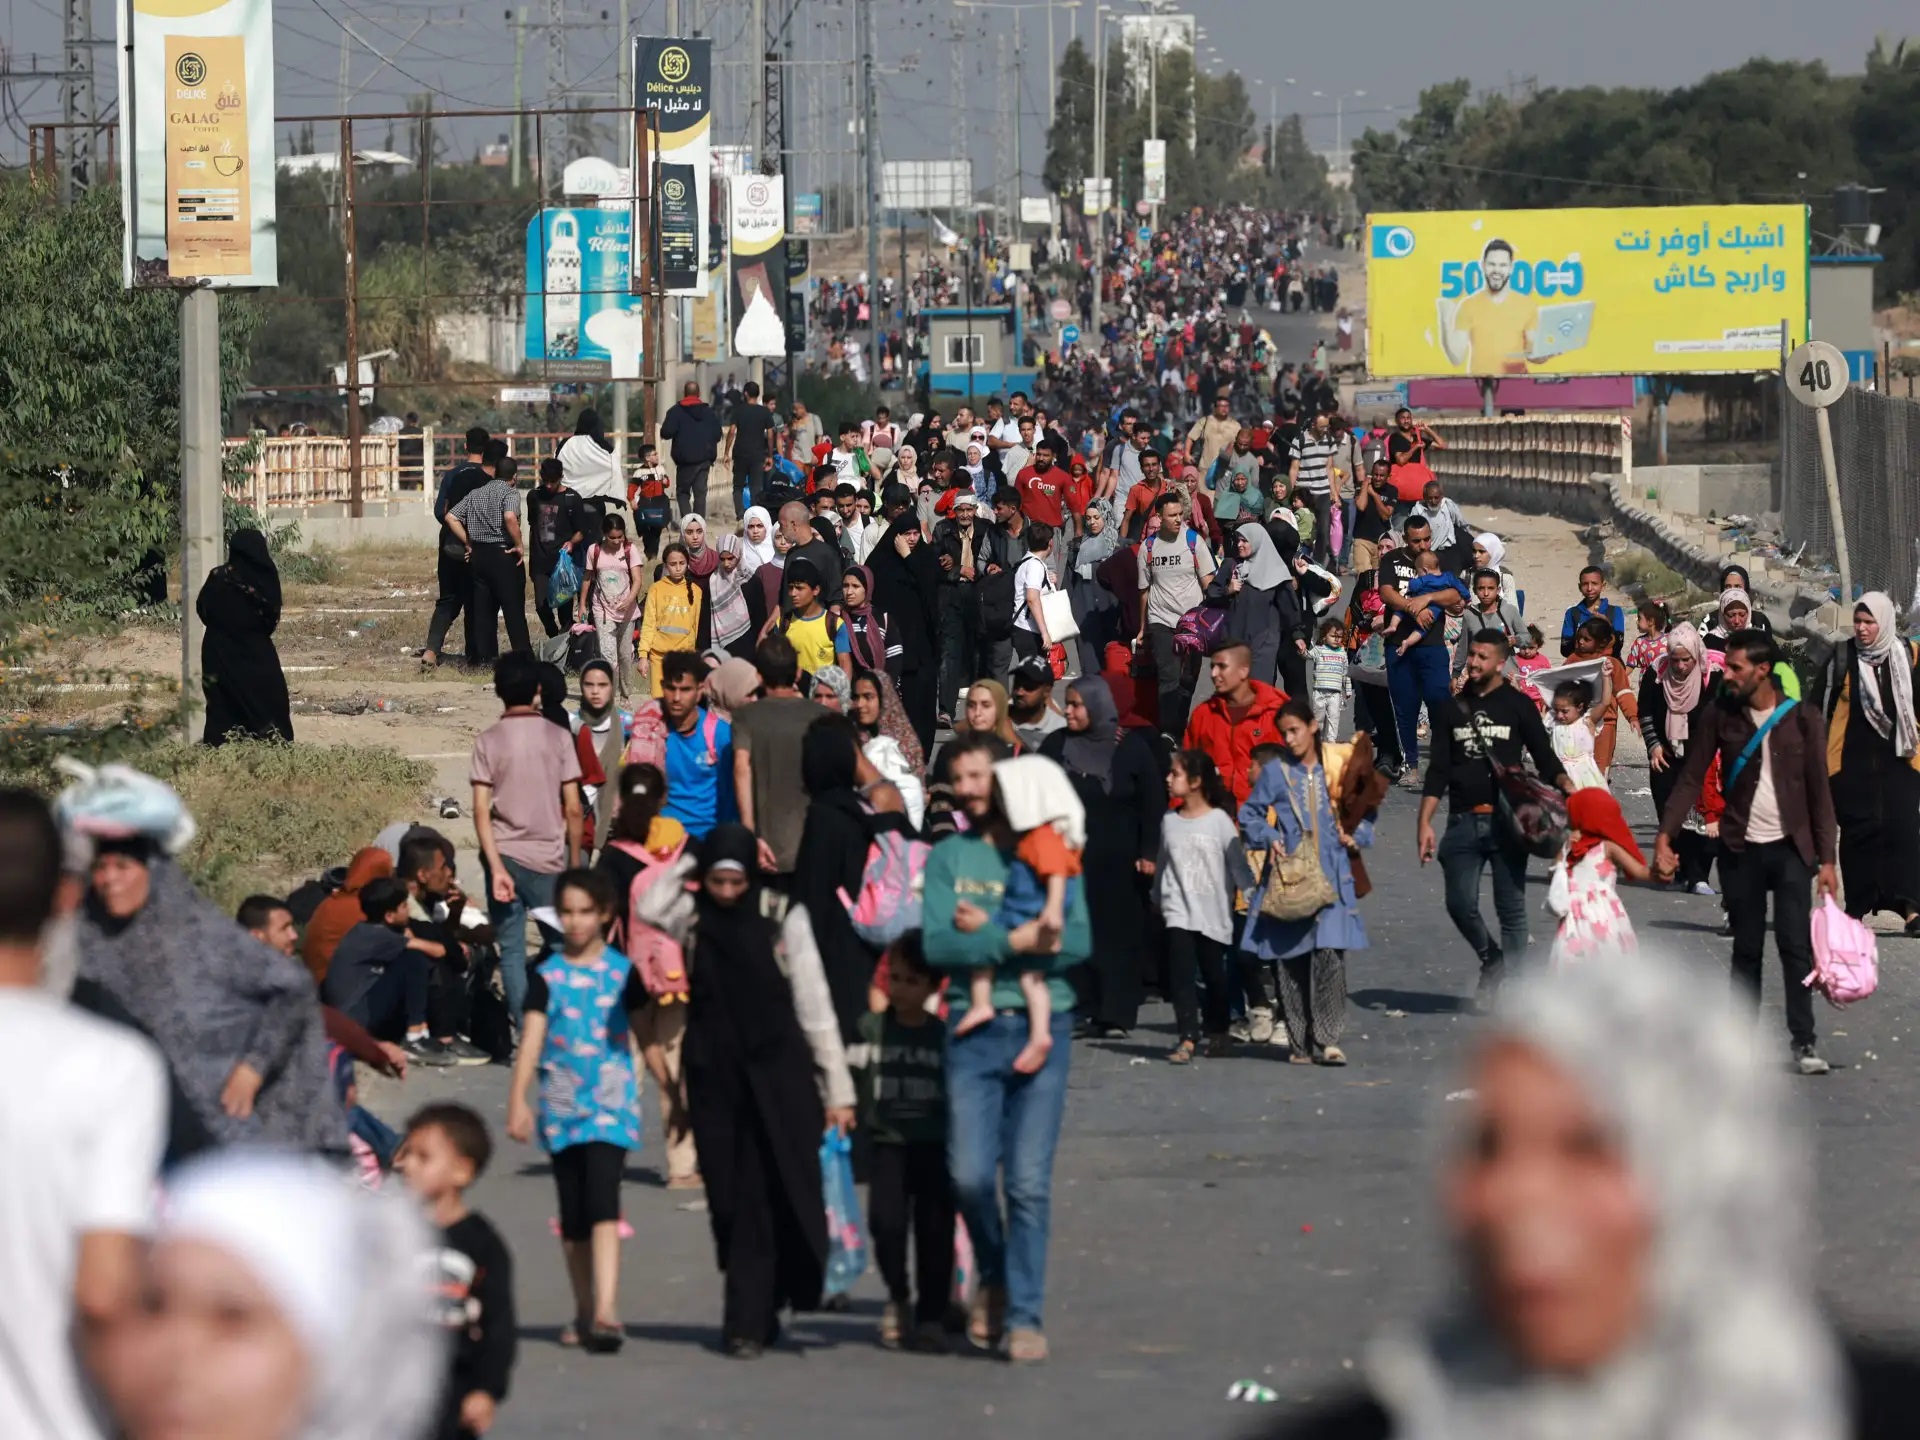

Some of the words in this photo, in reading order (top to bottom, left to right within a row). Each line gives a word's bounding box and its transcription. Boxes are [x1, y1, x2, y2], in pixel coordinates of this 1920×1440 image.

[647, 82, 674, 93] Délice
[676, 84, 702, 95] ديليس
[664, 97, 690, 113] مثيل
[692, 98, 702, 111] لا
[170, 112, 220, 124] GALAG
[1615, 229, 1651, 251] نت
[1657, 221, 1710, 257] أوفر
[1718, 222, 1784, 255] اشبك
[1653, 263, 1716, 293] كاش
[1725, 263, 1786, 294] واربح
[1800, 360, 1832, 392] 40
